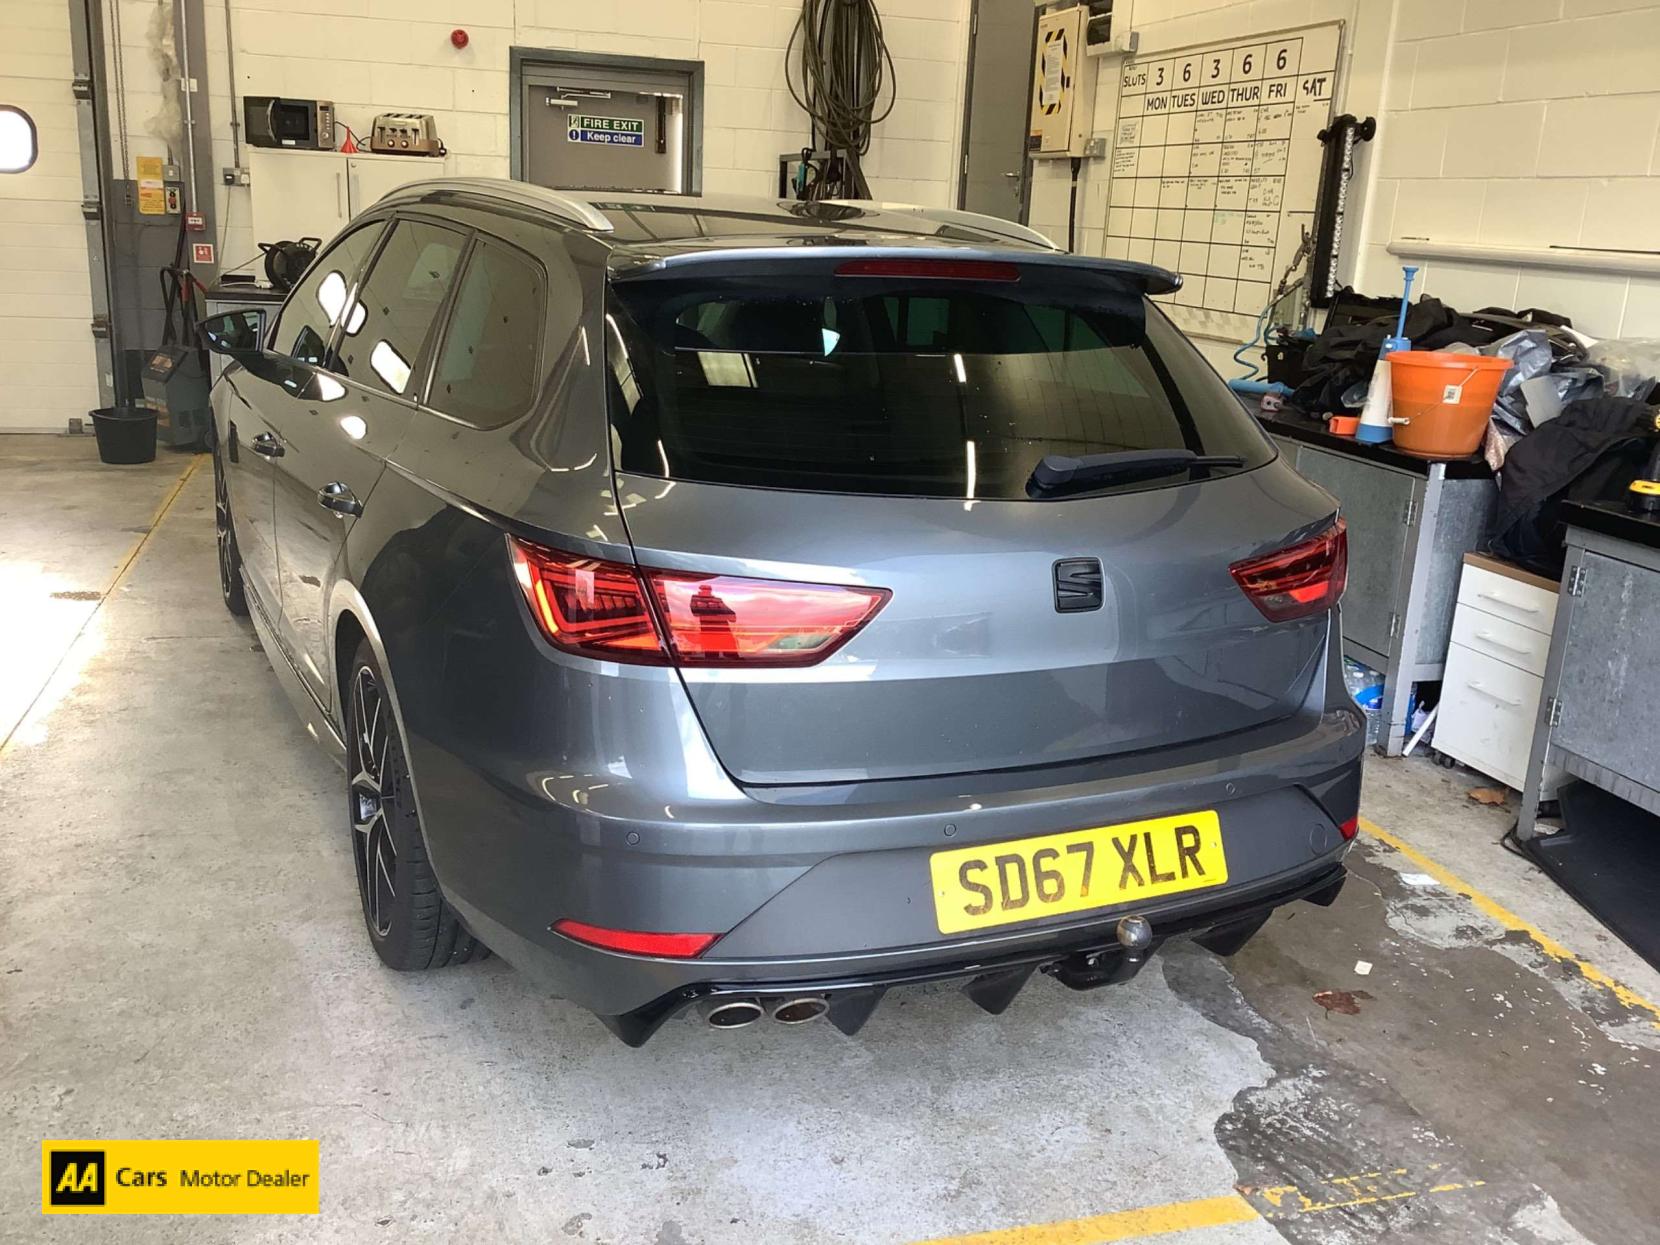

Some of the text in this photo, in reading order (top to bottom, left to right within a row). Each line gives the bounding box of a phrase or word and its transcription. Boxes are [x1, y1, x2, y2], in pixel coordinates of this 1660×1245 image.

[1155, 67, 1165, 86] 3
[1183, 63, 1192, 82] 6
[1211, 58, 1221, 79] 3
[1242, 53, 1253, 75] 6
[1276, 49, 1288, 70] 6
[1146, 77, 1327, 111] MON TUES WED THUR FRI SAT
[583, 118, 639, 131] FIRE EXIT
[586, 131, 637, 144] Keep clear
[958, 824, 1206, 916] SD67 XLR
